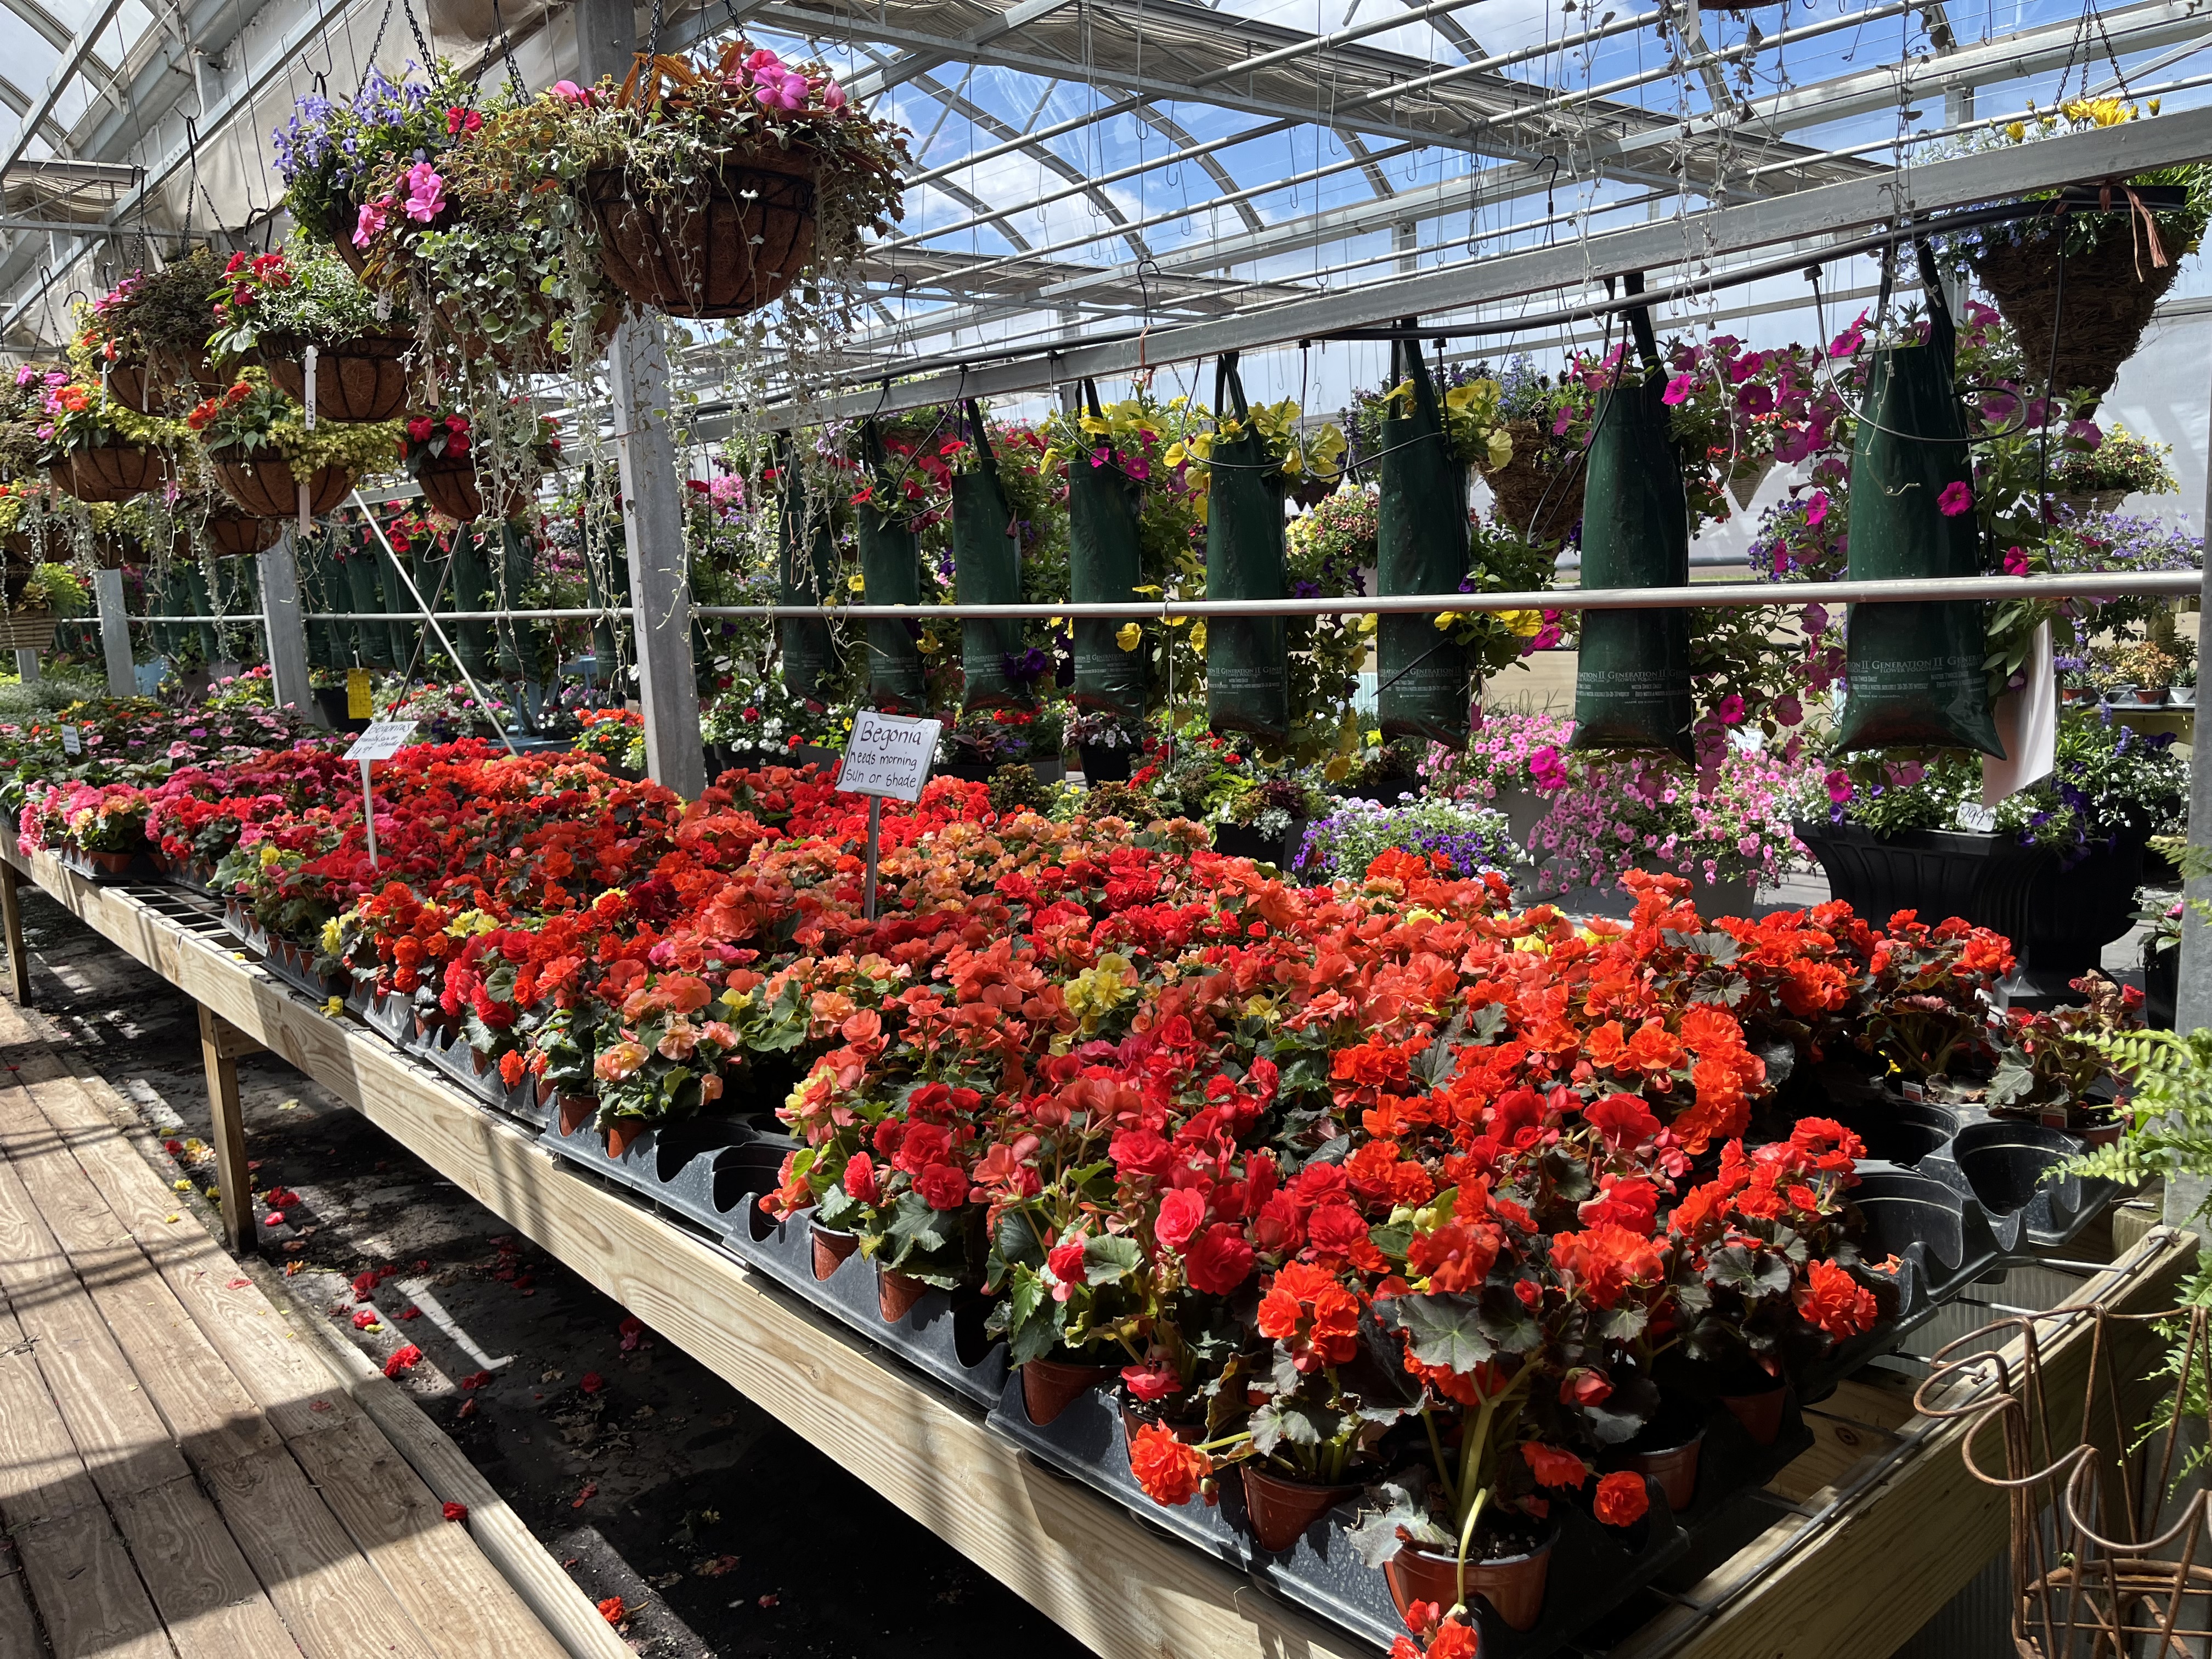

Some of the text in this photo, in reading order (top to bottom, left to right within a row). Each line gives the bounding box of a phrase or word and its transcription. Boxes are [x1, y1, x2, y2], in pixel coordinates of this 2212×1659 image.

[1872, 659, 1931, 669] GENERATION
[860, 721, 921, 751] Begonia
[850, 750, 917, 771] needs morning
[869, 774, 882, 783] or
